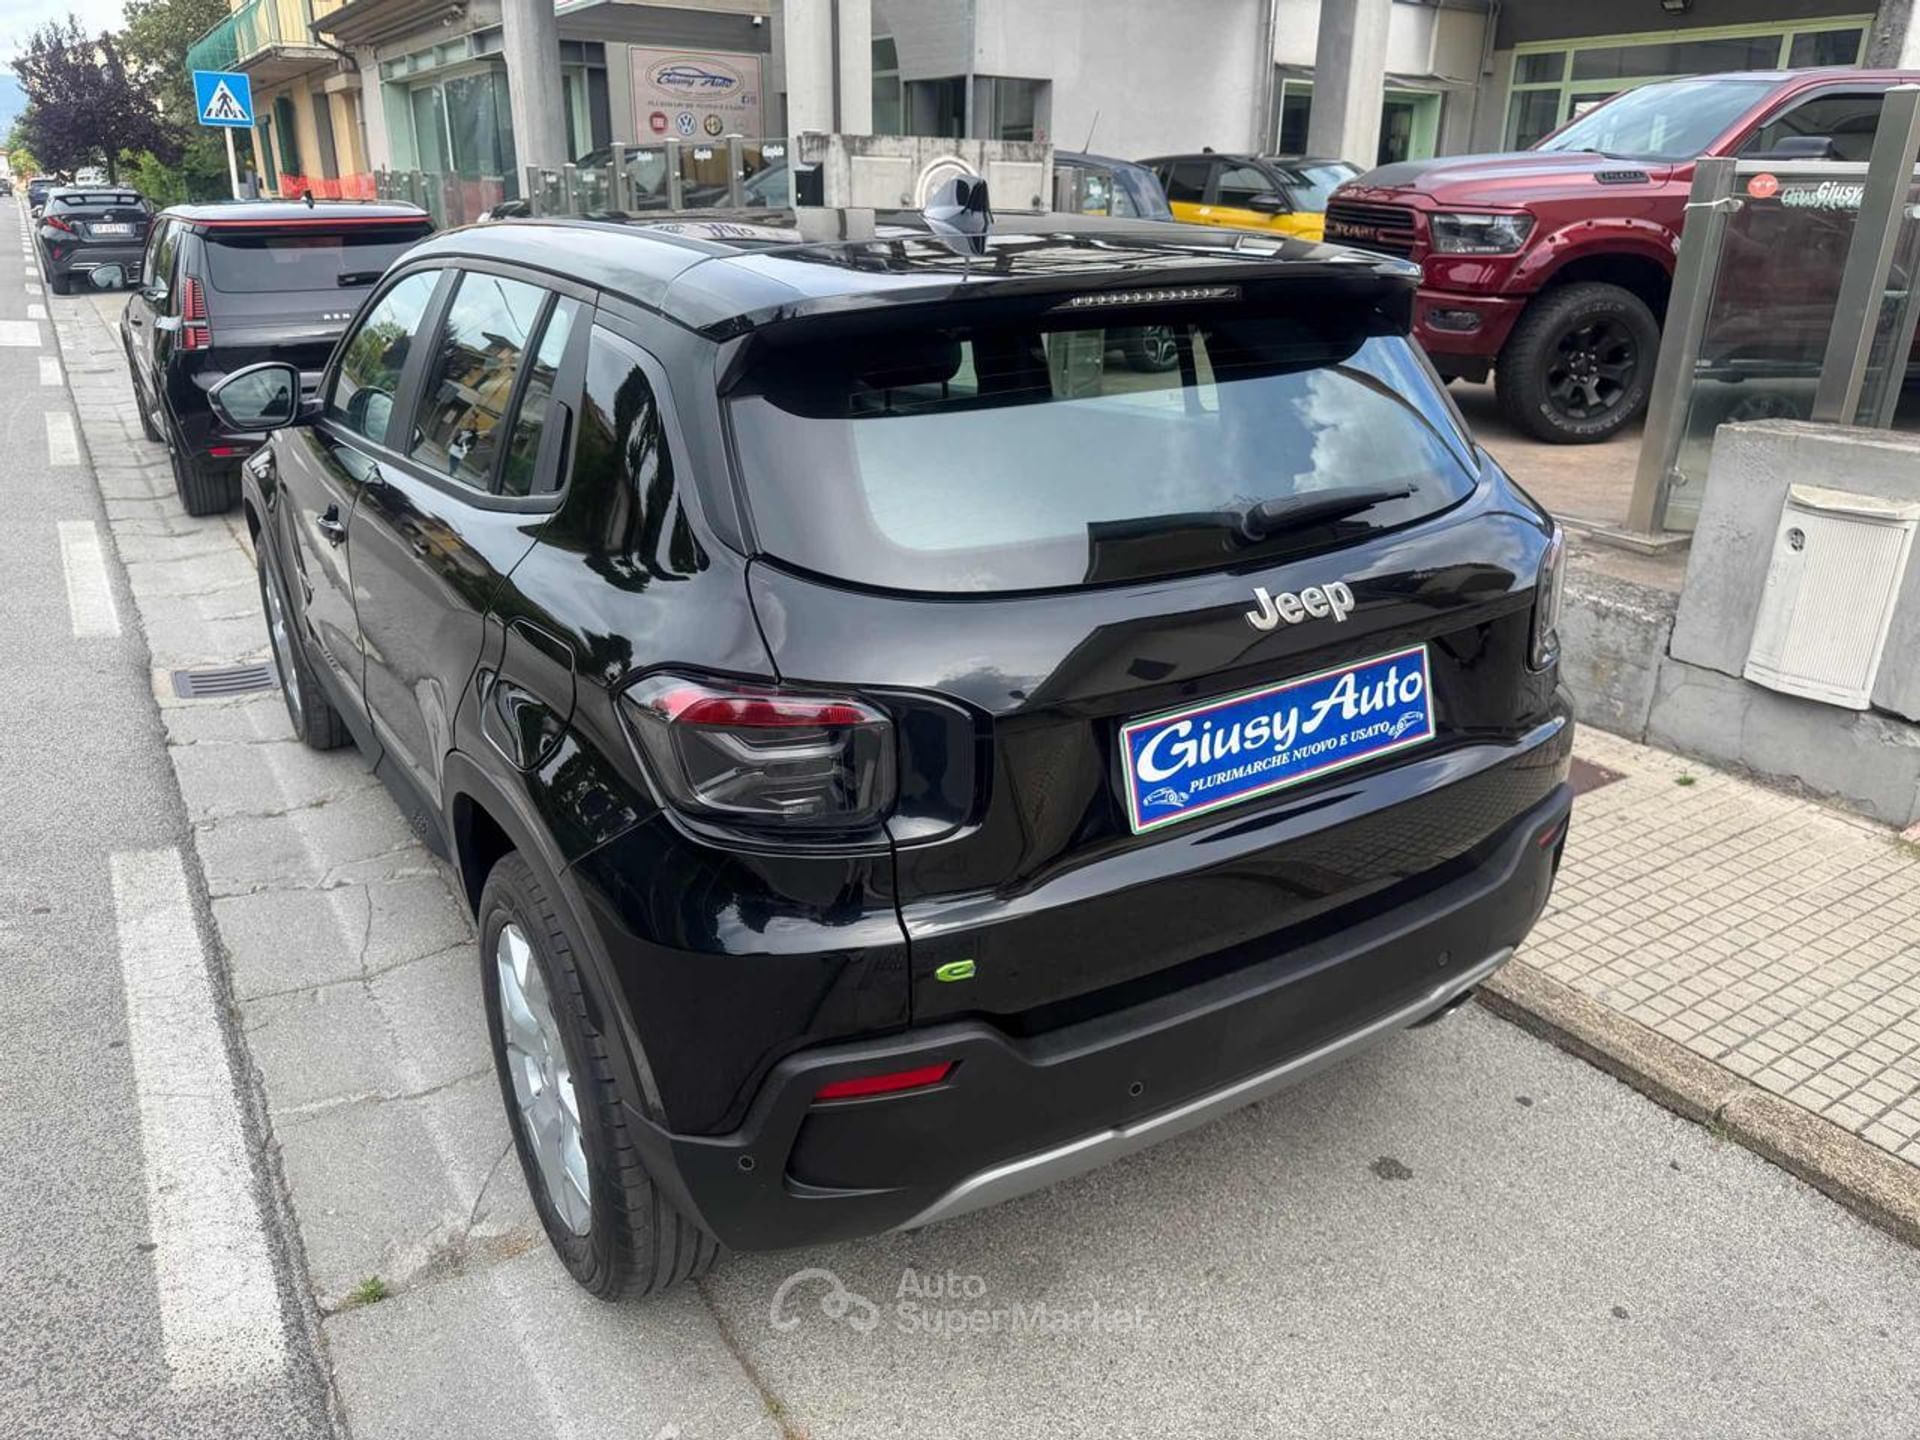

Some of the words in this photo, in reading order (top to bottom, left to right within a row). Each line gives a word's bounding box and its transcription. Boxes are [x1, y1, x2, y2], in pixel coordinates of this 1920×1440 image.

[1245, 580, 1355, 632] Jeep
[1137, 705, 1298, 783] Giusy
[1301, 664, 1423, 735] Auto
[1188, 749, 1291, 794] PLURIMARCHE
[1291, 735, 1339, 762] NUOVO
[1339, 736, 1350, 747] E
[1349, 721, 1391, 744] USATO
